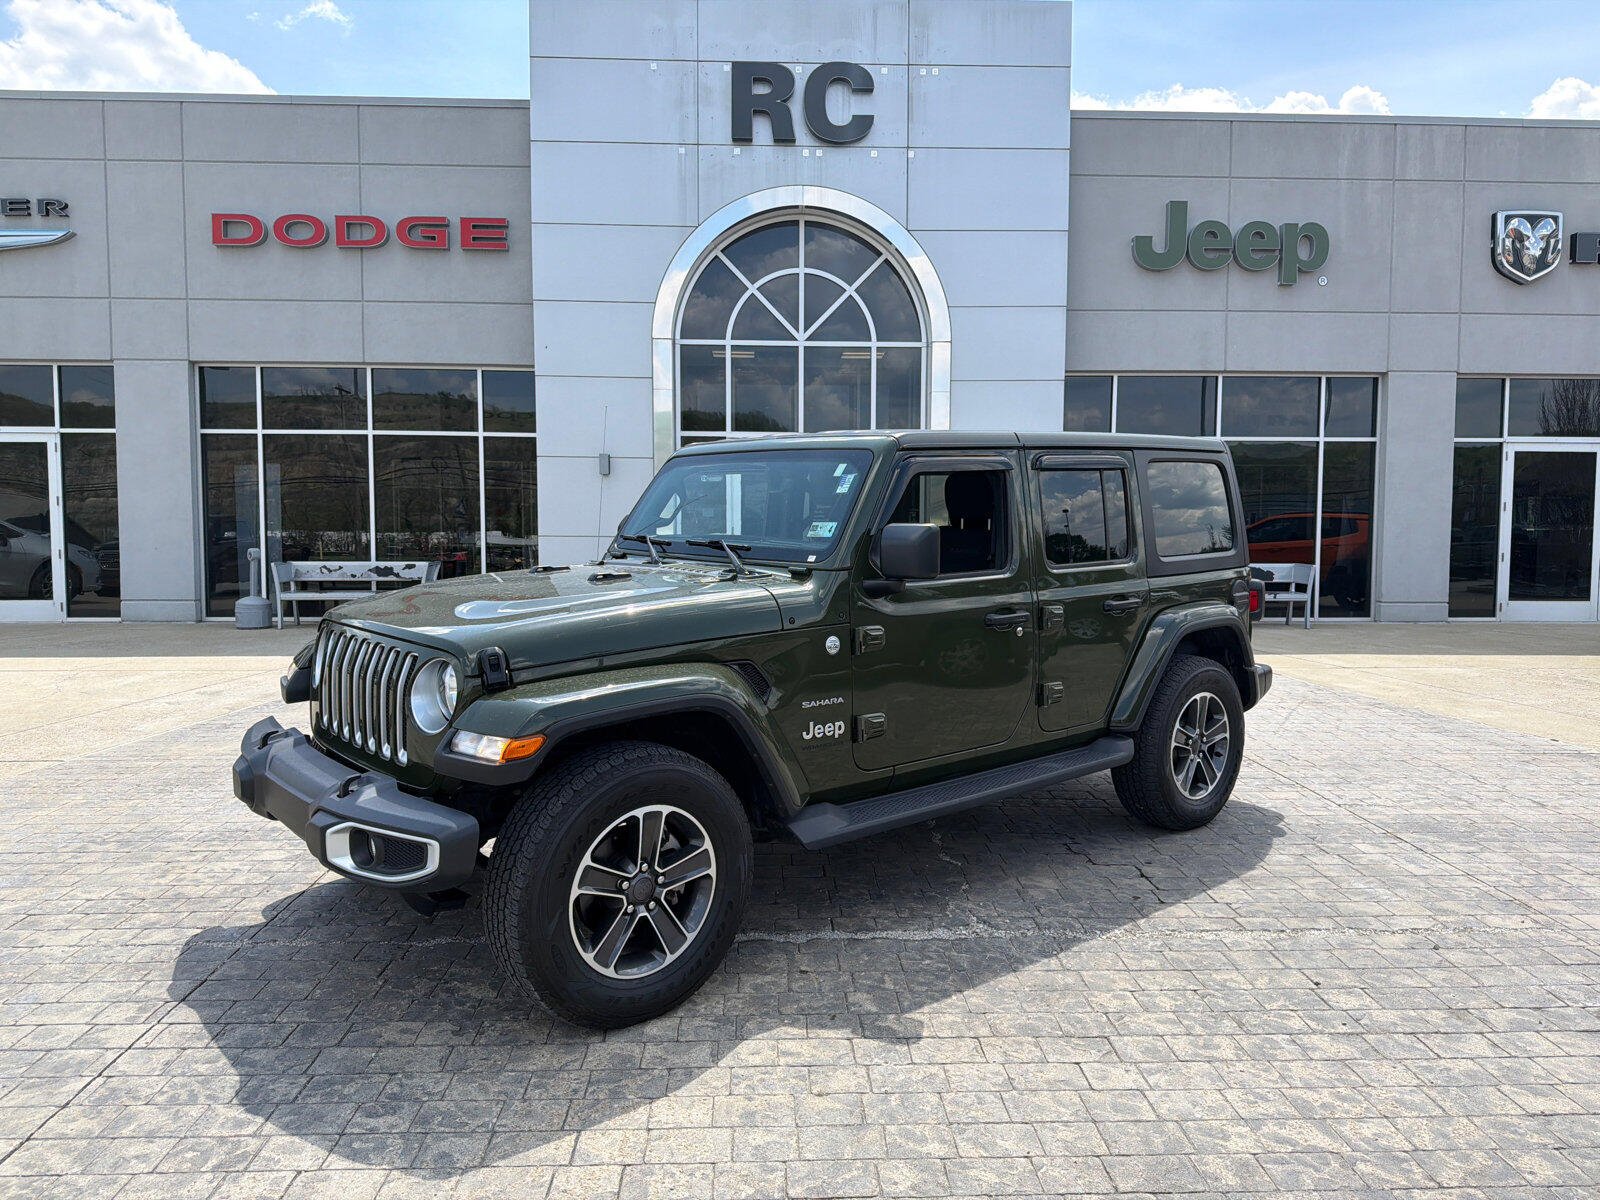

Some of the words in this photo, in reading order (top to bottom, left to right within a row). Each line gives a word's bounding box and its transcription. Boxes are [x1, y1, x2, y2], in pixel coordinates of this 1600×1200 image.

[731, 61, 875, 145] RC
[212, 213, 509, 252] DODGE
[1132, 200, 1330, 287] Jeep
[801, 697, 845, 709] SAHARA
[802, 720, 845, 740] Jeep
